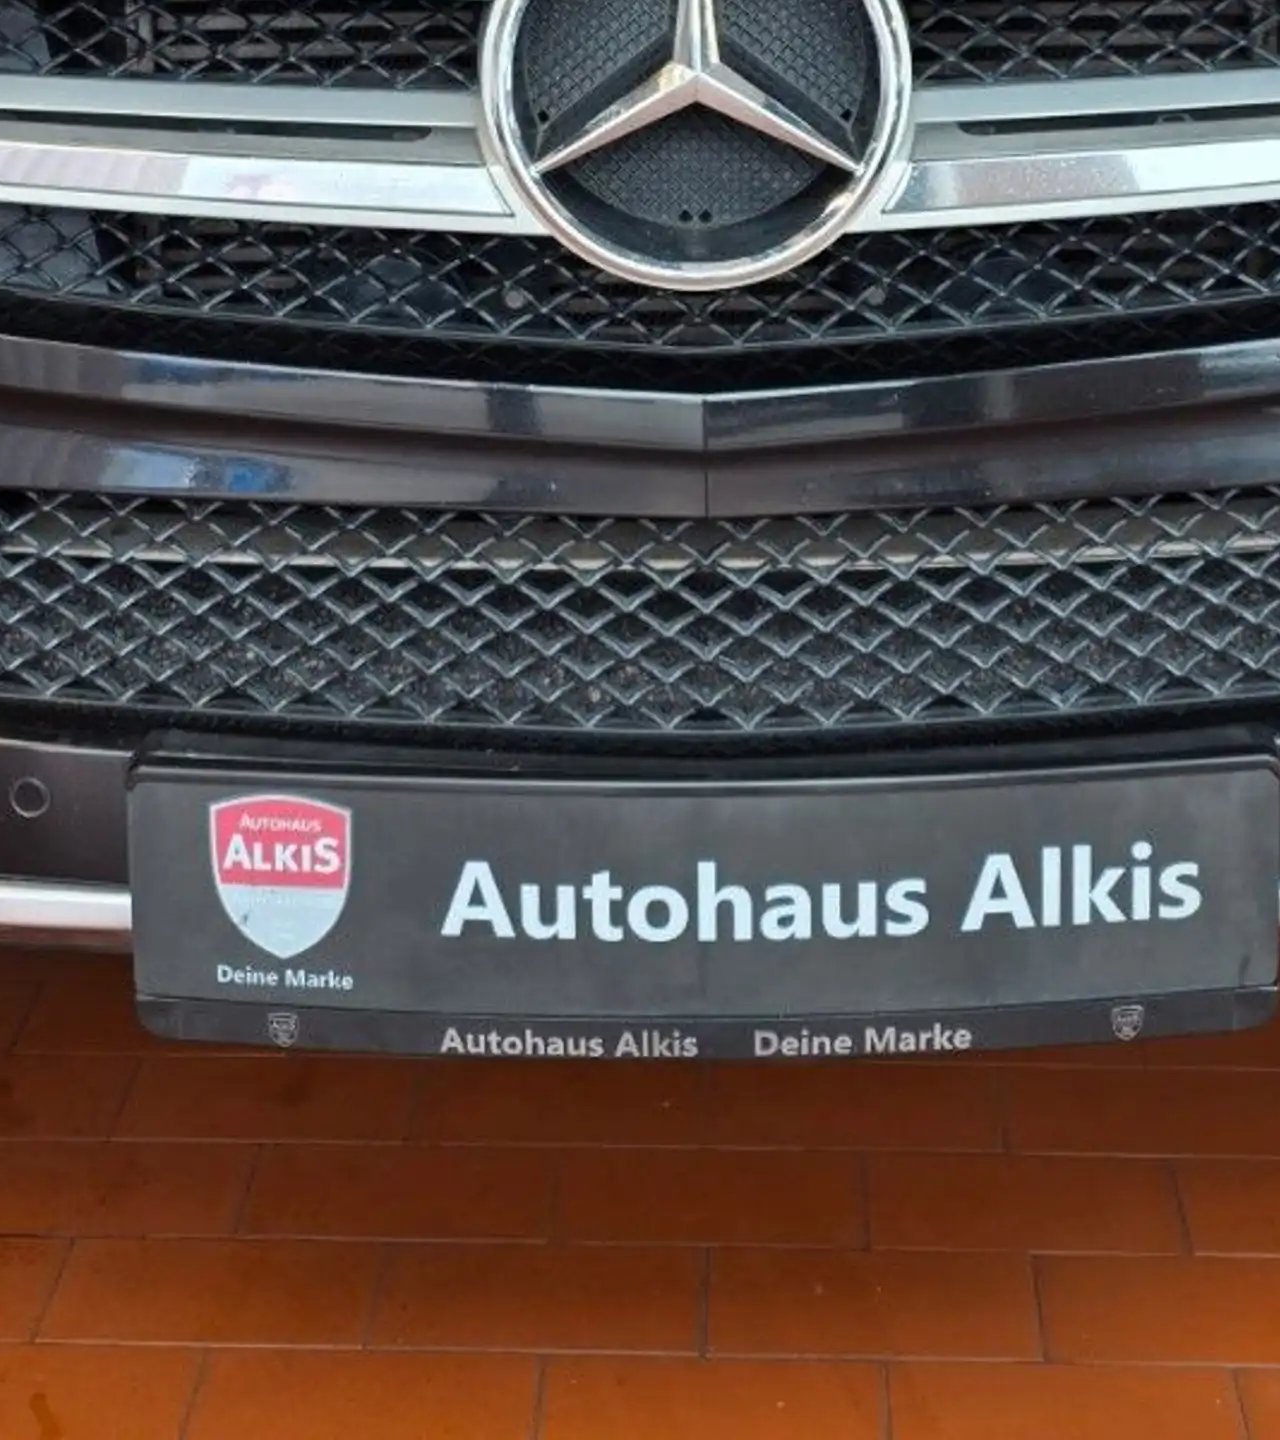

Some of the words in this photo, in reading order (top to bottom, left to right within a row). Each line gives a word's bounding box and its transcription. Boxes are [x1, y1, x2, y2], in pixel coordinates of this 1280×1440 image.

[239, 813, 321, 833] AUTOHAUS
[222, 833, 342, 875] ALKIS
[440, 860, 929, 942] Autohaus
[960, 841, 1203, 932] Alkis
[217, 964, 278, 986] Deine
[284, 968, 354, 990] Marke
[440, 1027, 604, 1057] Autohaus
[615, 1029, 698, 1058] Alkis
[753, 1027, 853, 1056] Deine
[864, 1024, 973, 1055] Marke
